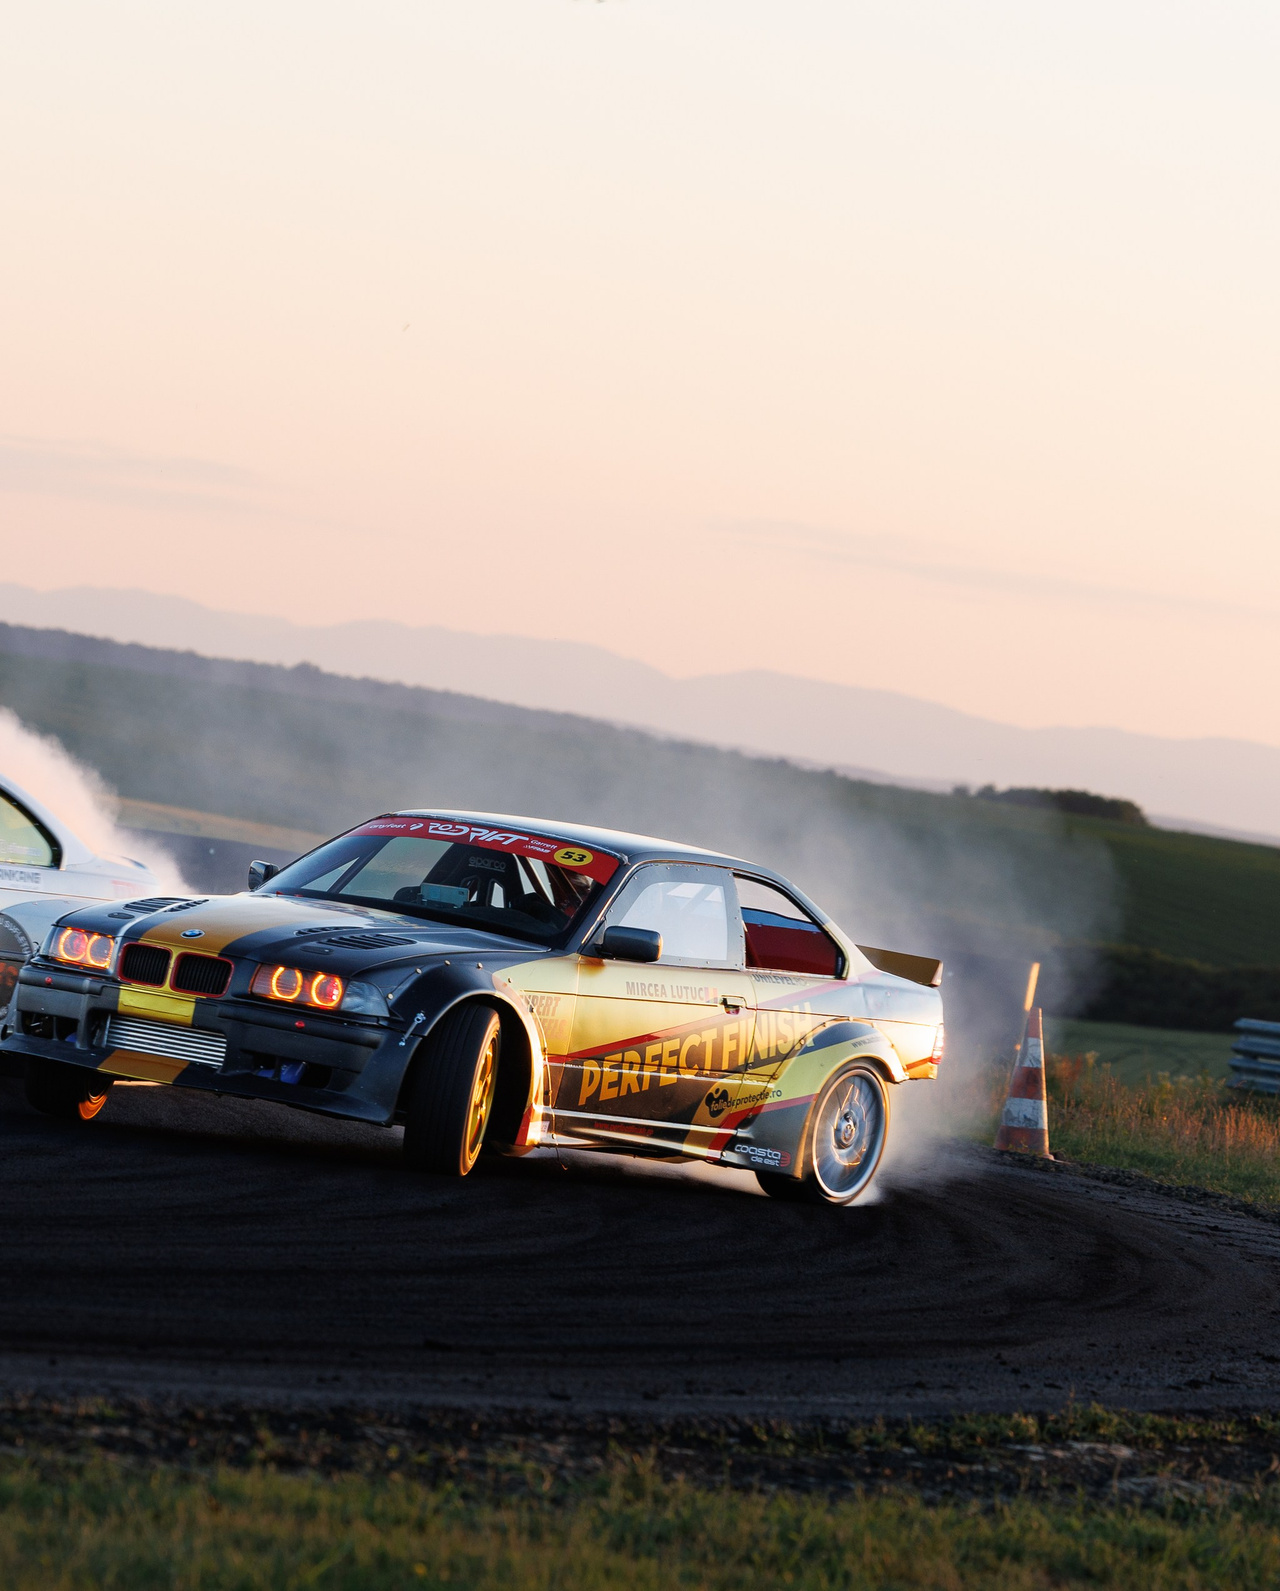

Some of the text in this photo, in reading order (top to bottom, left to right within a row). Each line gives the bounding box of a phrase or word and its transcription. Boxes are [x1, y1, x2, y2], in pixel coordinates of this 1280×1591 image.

[530, 839, 558, 849] Garrett
[469, 856, 507, 870] sparco
[560, 851, 587, 863] 53
[625, 981, 704, 1001] MIRCEA LUTUC
[578, 1001, 816, 1106] PERFECT FINISH
[734, 1144, 781, 1160] coasta
[750, 1155, 780, 1166] de est
